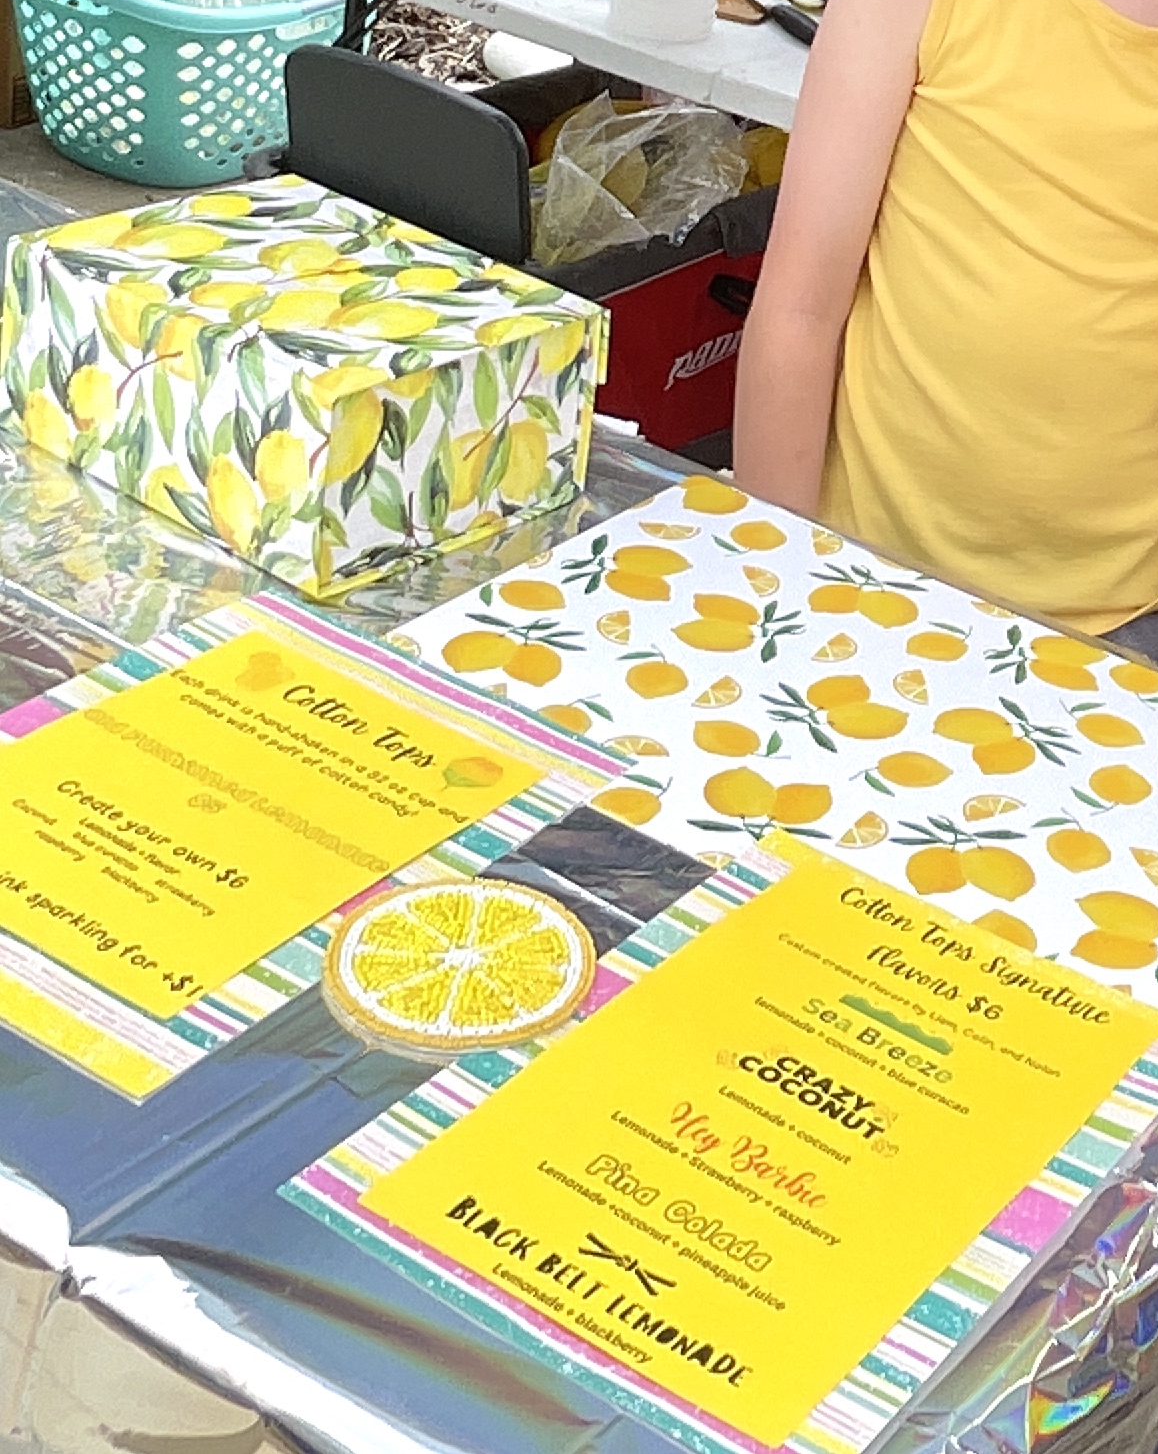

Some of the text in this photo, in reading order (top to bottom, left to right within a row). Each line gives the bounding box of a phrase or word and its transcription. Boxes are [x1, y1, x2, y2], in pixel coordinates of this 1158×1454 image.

[178, 693, 226, 719] comes
[225, 716, 258, 735] with
[317, 765, 370, 793] cotton
[282, 684, 436, 769] Cotton Tops
[56, 779, 250, 889] Create your own $6
[436, 807, 471, 825] and
[24, 892, 120, 953] sparkling
[117, 944, 159, 970] for
[839, 886, 1110, 1024] Cotton Tops Signature
[801, 997, 953, 1084] Sea Breeze
[824, 1035, 879, 1069] coconut
[965, 995, 1004, 1021] $6
[717, 1084, 787, 1128] Lemonade
[795, 1129, 853, 1166] coconut
[738, 1055, 886, 1140] COCONUT
[769, 1055, 876, 1120] CRAZY
[610, 1109, 680, 1155] Lemonade
[771, 1205, 842, 1247] raspberry
[669, 1100, 827, 1209] Hey Barbie
[536, 1159, 608, 1207] Lemonade
[676, 1246, 751, 1291] pineapple
[745, 1284, 787, 1312] juice
[583, 1153, 774, 1274] Pina Colada
[445, 1195, 753, 1388] BLACK BELT LEMONADE
[491, 1262, 566, 1313] Lemonade
[573, 1311, 654, 1365] blackberry
